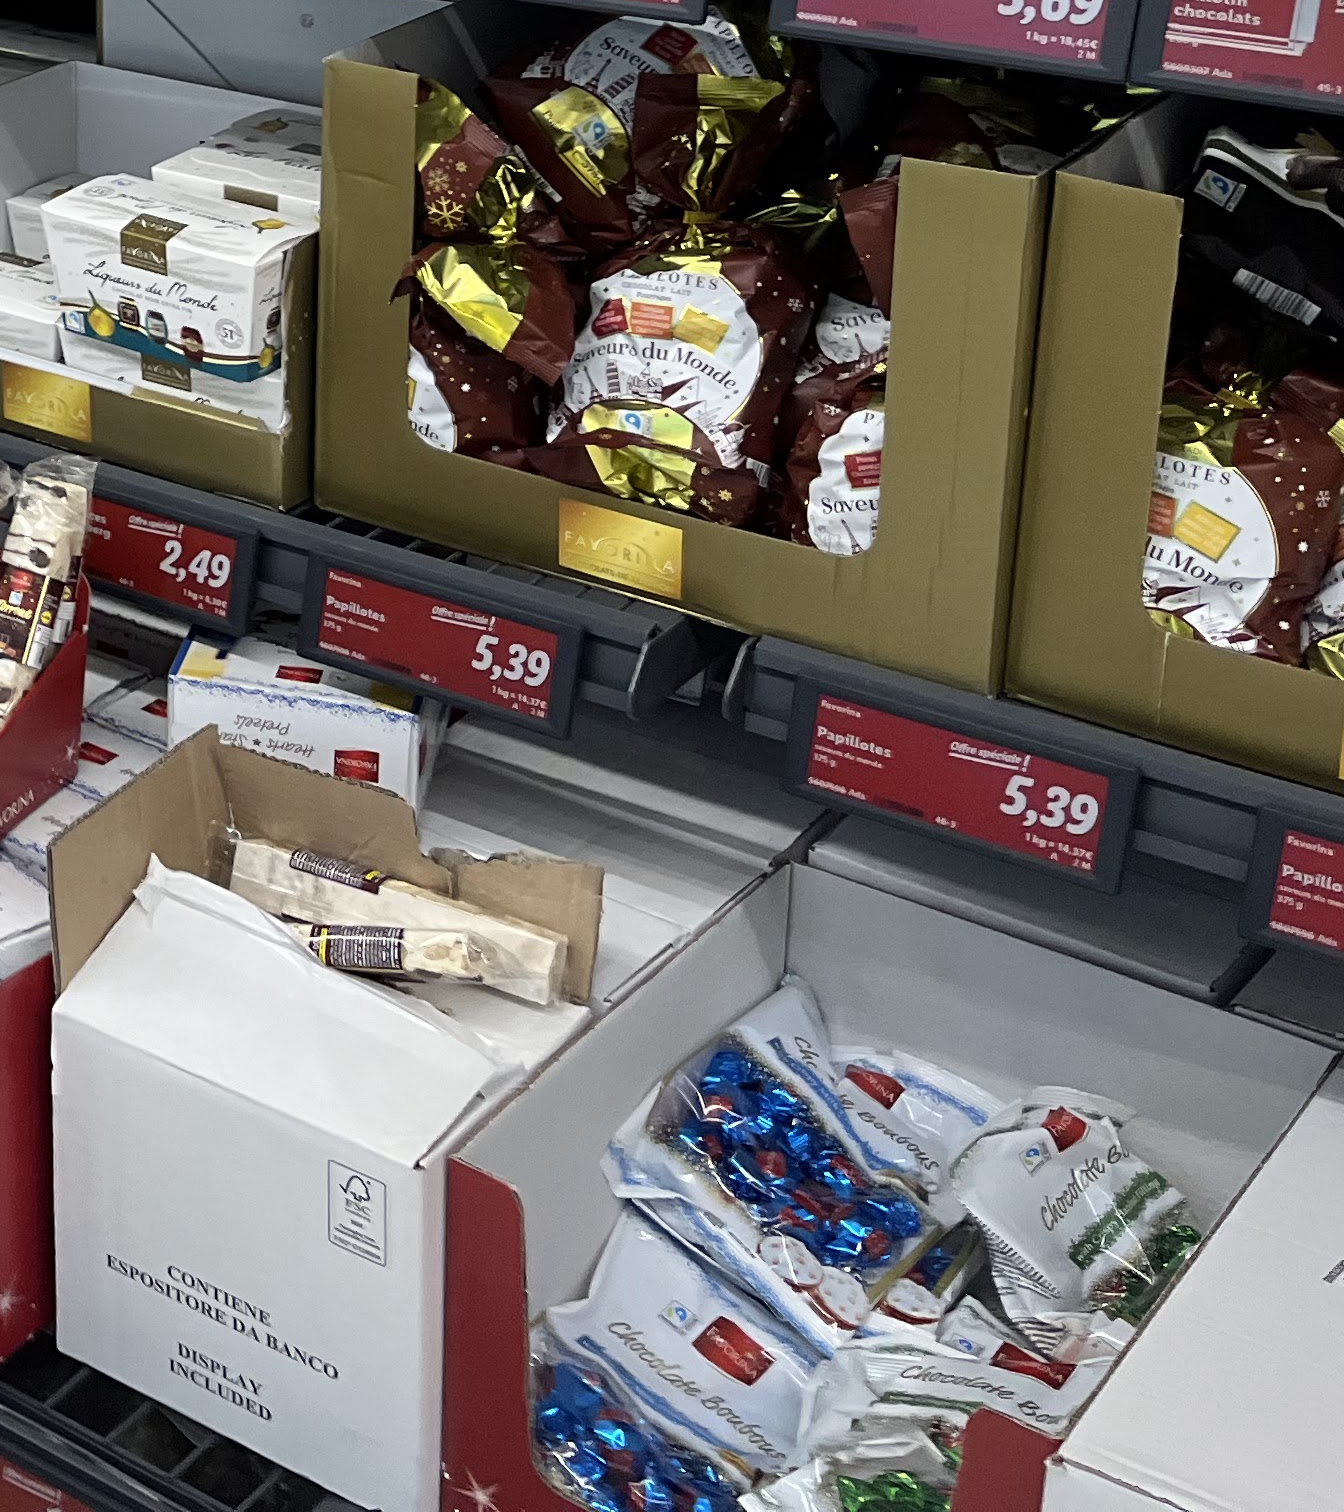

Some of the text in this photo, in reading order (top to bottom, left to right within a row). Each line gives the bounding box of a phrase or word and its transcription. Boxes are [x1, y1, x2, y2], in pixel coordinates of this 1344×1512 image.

[1173, 3, 1261, 26] chocolats
[145, 283, 163, 297] du
[166, 281, 219, 312] Monde
[830, 310, 882, 334] Save
[572, 341, 737, 390] Saveurs du Monde
[820, 494, 879, 515] Saveu
[159, 539, 231, 588] 2,49
[325, 594, 386, 623] Papillotes
[471, 634, 551, 687] 5,39
[816, 725, 892, 759] Papillotes
[999, 774, 1099, 835] 5,39
[105, 1253, 340, 1381] ESPOSITORE DA BANCO
[166, 1263, 272, 1330] CONTIENE
[176, 1341, 265, 1398] DISPLAY
[608, 1321, 703, 1398] Chocolate
[900, 1364, 1015, 1401] Chocolate
[167, 1355, 273, 1423] INCLUDED
